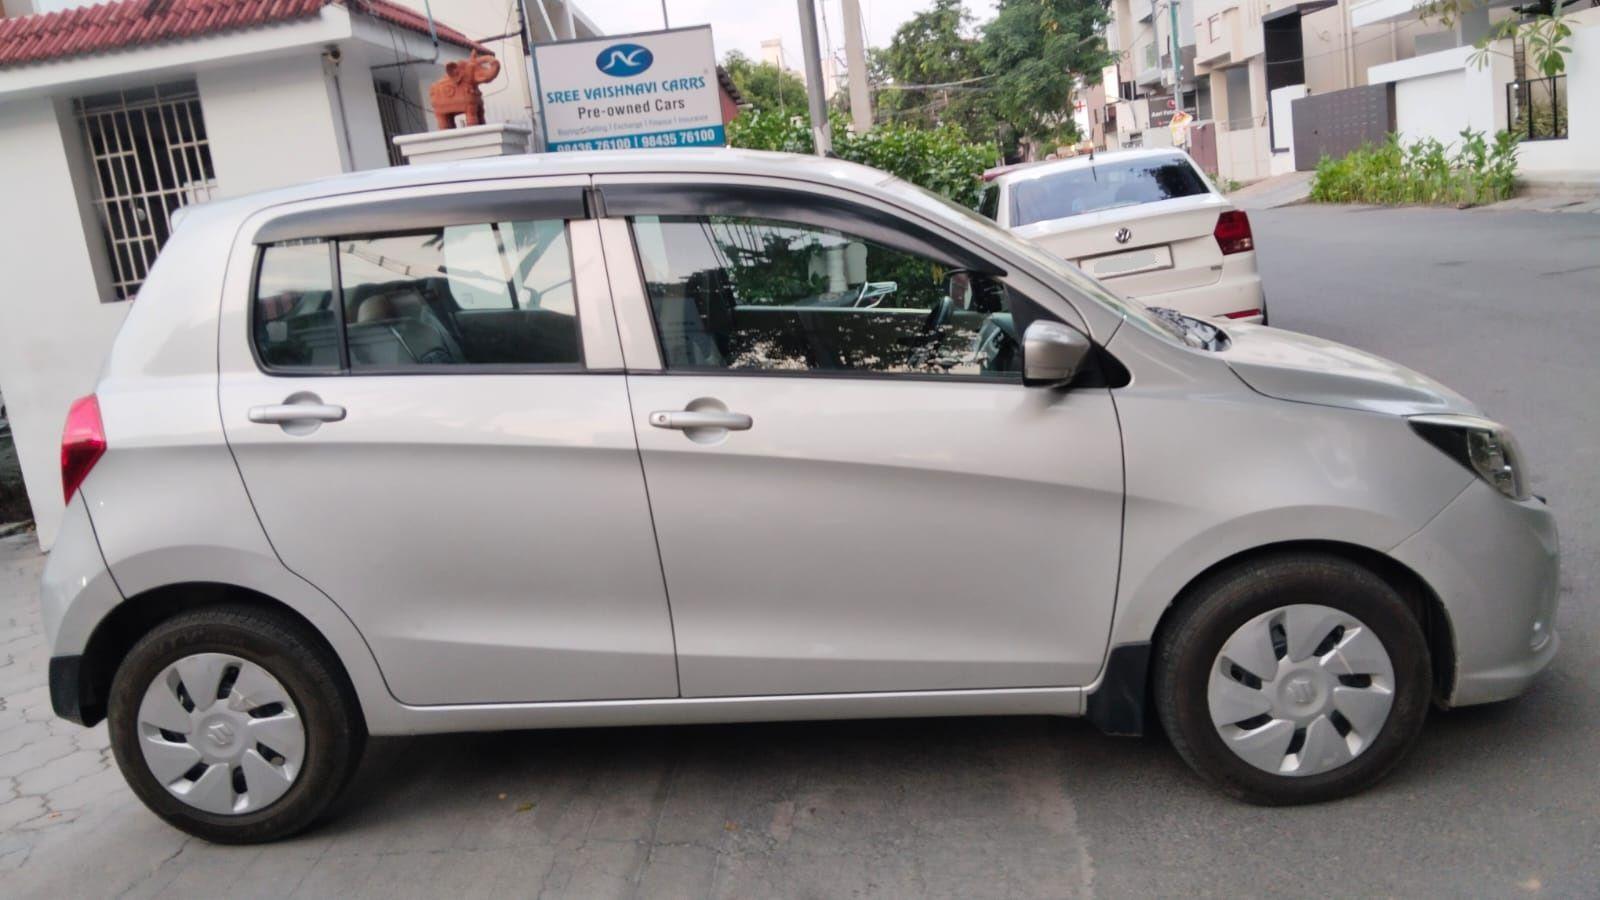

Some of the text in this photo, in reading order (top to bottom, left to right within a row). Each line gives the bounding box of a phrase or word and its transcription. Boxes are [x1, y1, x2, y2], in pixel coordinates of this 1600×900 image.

[546, 76, 706, 104] SREE VAISHNAVI CARRS
[577, 99, 686, 119] Pre-owned Cars
[641, 132, 677, 147] 98435
[680, 128, 716, 144] 76100
